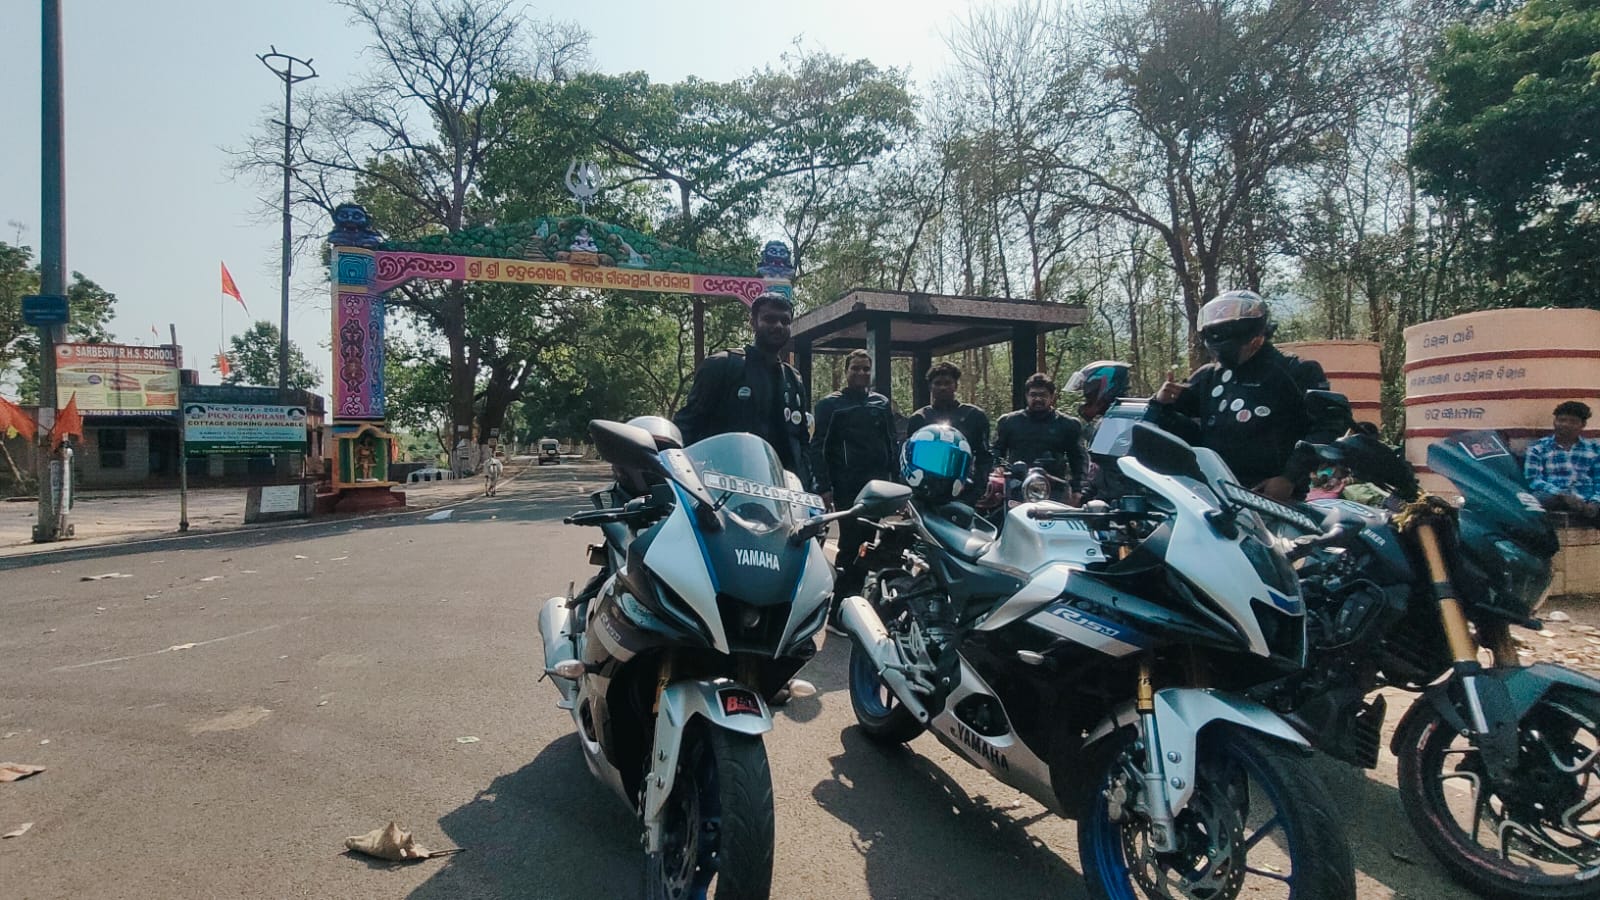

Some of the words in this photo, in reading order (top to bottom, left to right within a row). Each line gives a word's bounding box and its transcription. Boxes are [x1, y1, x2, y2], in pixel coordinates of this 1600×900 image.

[76, 346, 126, 358] SARBESWAR
[127, 348, 142, 358] H.S.
[144, 349, 174, 360] SCHOOL
[735, 549, 780, 571] YAMAHA
[957, 722, 1009, 771] YAMAHA
